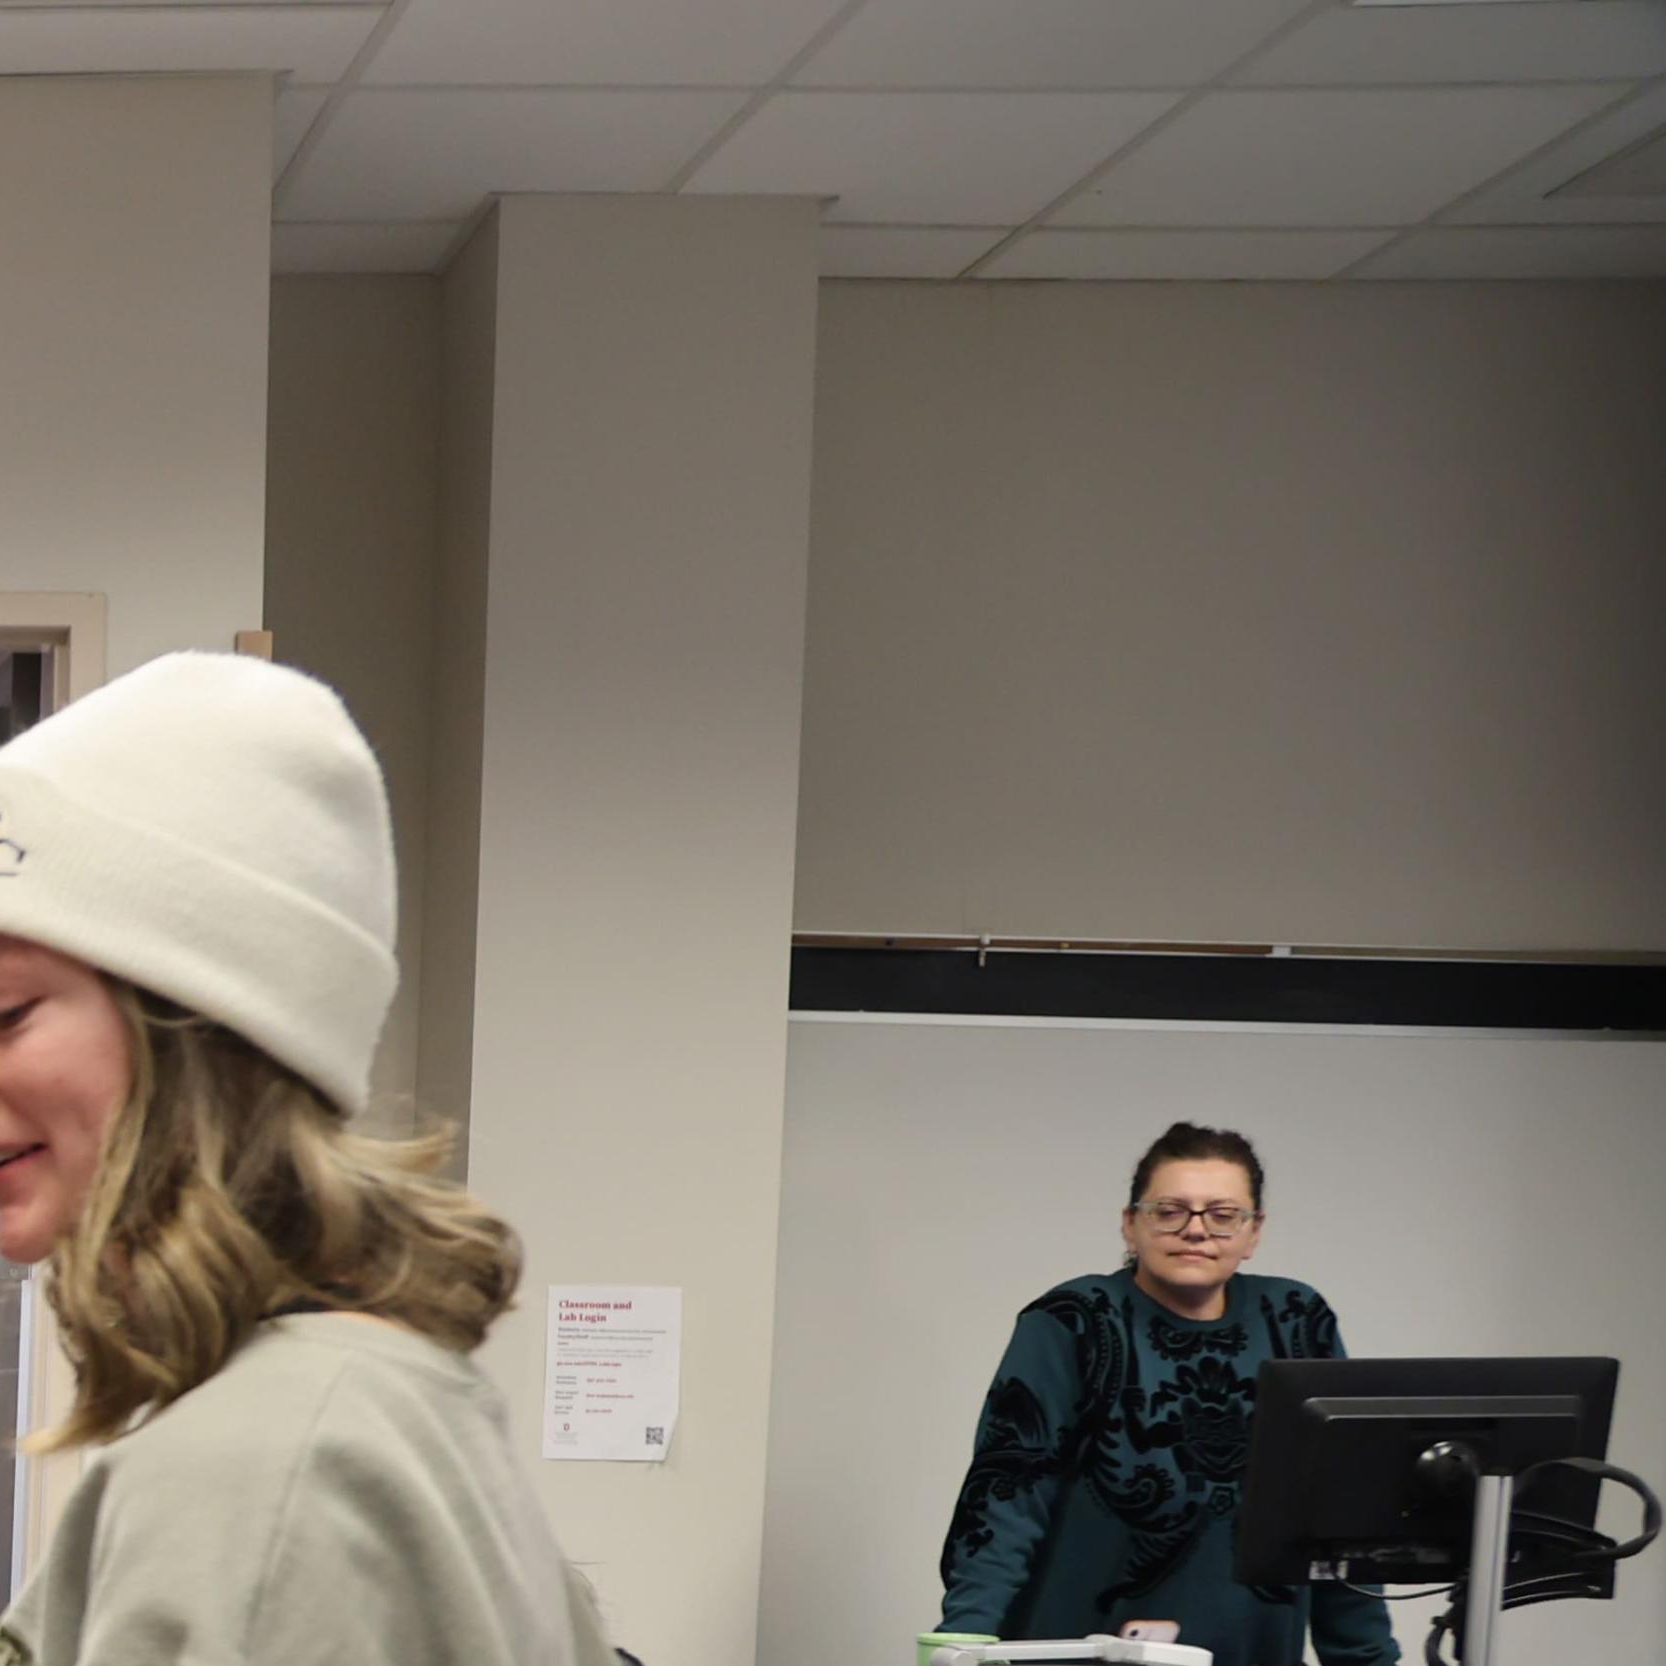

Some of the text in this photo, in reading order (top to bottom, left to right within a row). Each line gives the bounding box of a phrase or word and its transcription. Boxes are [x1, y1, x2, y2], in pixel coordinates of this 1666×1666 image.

[559, 1300, 632, 1310] Classroom and
[559, 1313, 607, 1323] Lab Login
